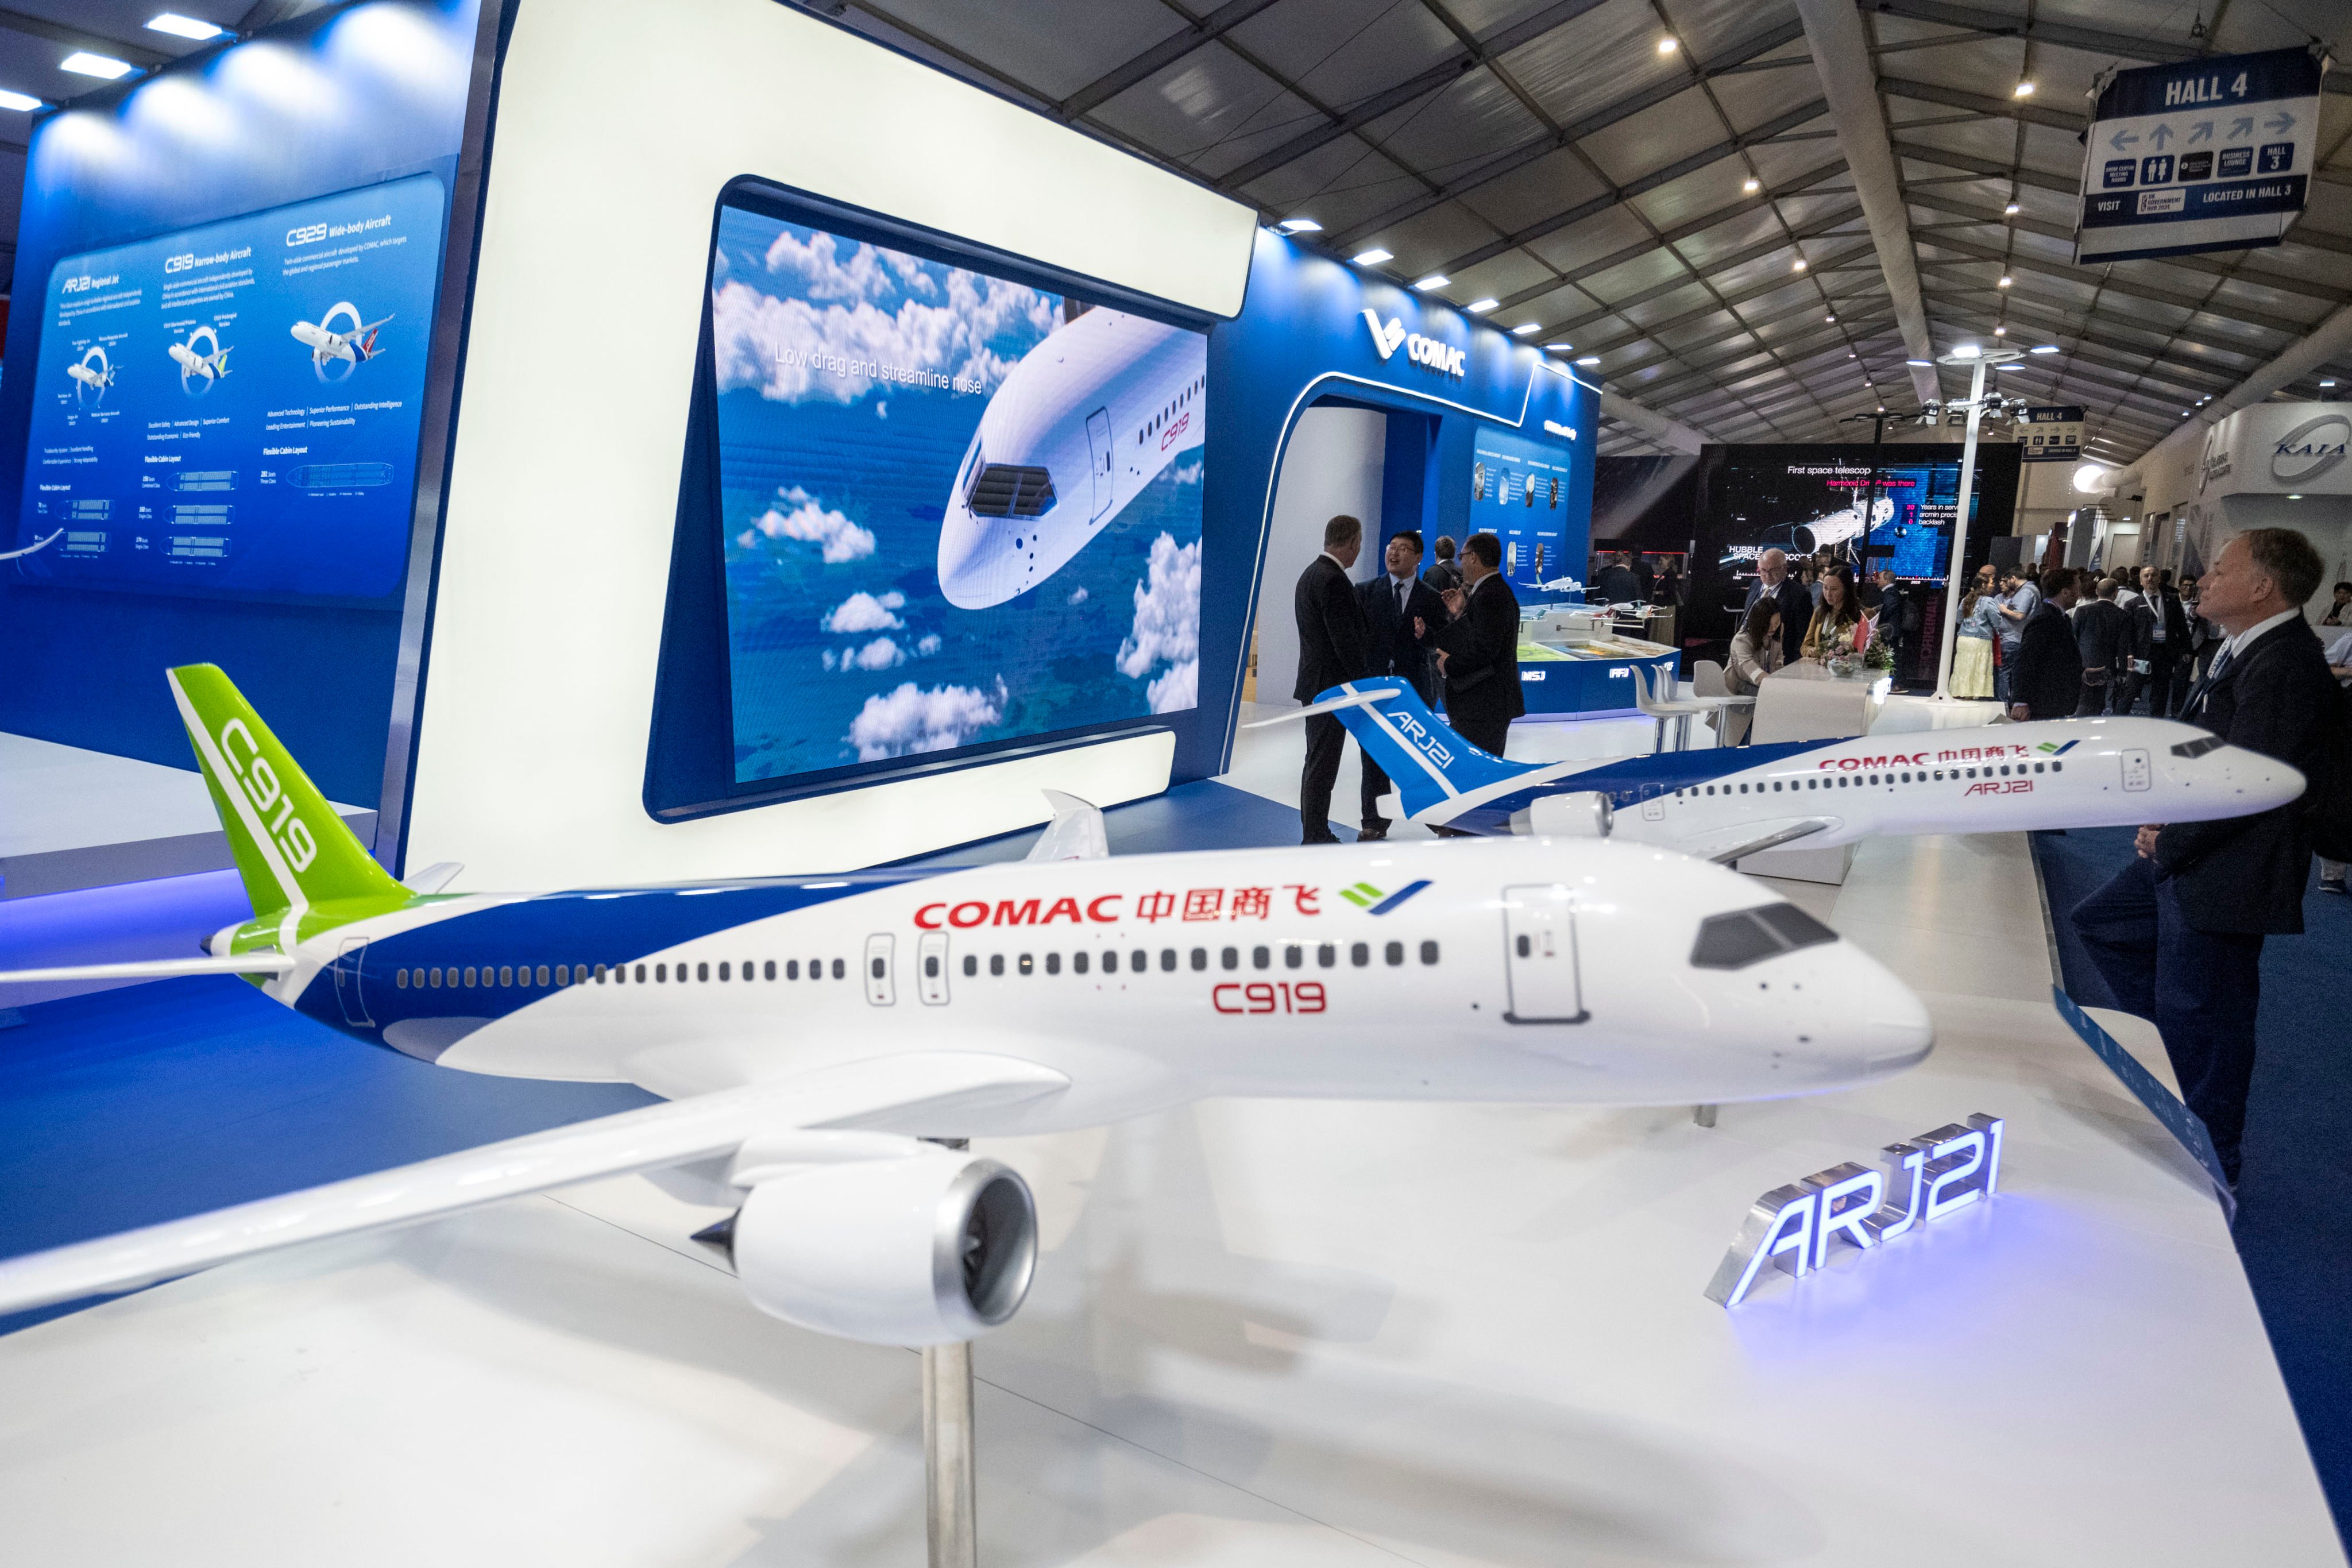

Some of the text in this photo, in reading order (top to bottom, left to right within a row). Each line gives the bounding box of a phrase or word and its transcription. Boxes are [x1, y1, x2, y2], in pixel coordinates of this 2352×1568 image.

[2165, 71, 2247, 106] HALL 4
[2222, 152, 2250, 160] BUSINESS
[2267, 146, 2286, 156] HALL
[2270, 156, 2280, 170] 3
[2203, 184, 2291, 203] LOCATED IN HALL 3
[2098, 200, 2121, 211] VISIT
[286, 214, 391, 247] C929 Wide-body Aircraft
[339, 245, 358, 256] developed
[380, 238, 392, 247] which
[392, 236, 407, 246] targets
[165, 246, 252, 273] C919 Narrow-body Aircraft
[62, 275, 91, 294] ARJ21
[91, 275, 111, 289] Regional
[1408, 333, 1466, 377] COMAC
[775, 341, 982, 395] Low drag and streamline nose
[268, 400, 402, 418] Advanced Technology Superior Performance Outstanding Intelligence
[2036, 412, 2063, 421] HALL 4
[266, 418, 356, 431] Leading Entertainment Pioneering Sustainability
[1161, 412, 1189, 452] C919
[263, 446, 308, 455] Flexible Cabin Layout
[1787, 466, 1872, 476] First space telescop
[1729, 546, 1764, 554] HUBBLE
[1387, 712, 1455, 769] ARJ21
[1819, 745, 2030, 773] COMAC 中国商飞
[221, 718, 317, 873] C919
[1964, 780, 2033, 797] ARJ21
[914, 883, 1322, 930] COMAC 中国商飞
[1213, 982, 1327, 1014] C919
[1724, 1118, 2005, 1310] ARJ21
